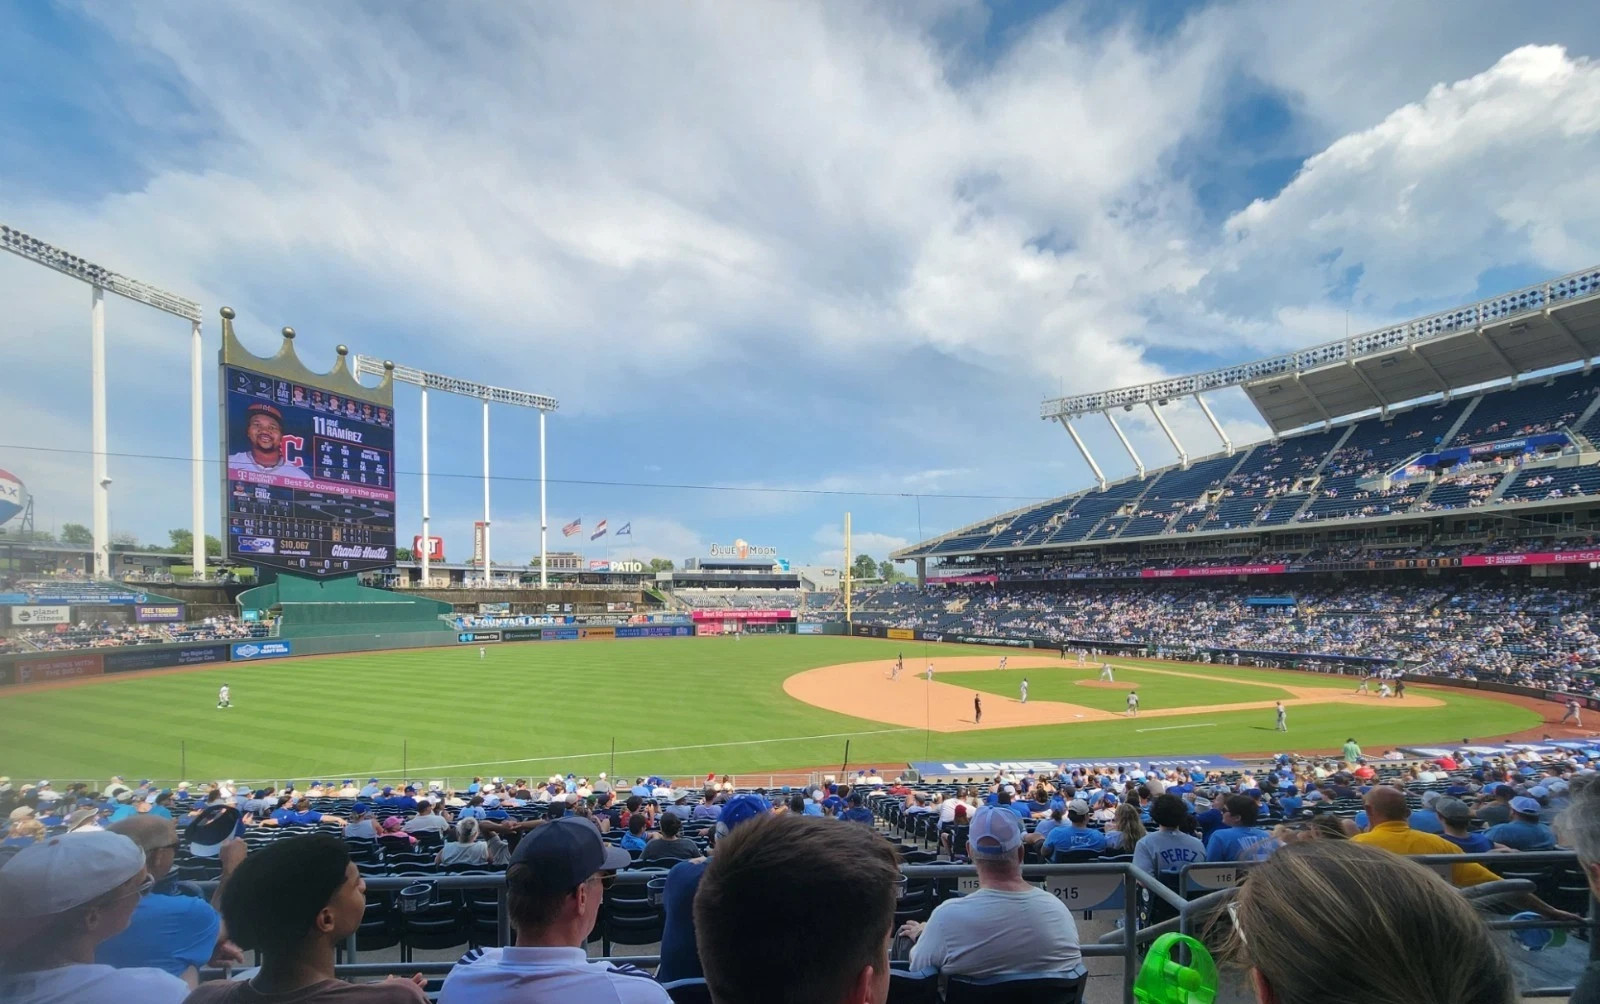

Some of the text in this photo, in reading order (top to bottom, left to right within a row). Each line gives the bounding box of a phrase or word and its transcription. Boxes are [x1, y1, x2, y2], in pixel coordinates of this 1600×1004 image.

[280, 382, 287, 390] AT
[277, 389, 289, 398] BAT
[312, 416, 326, 435] 11
[326, 426, 362, 443] RAMÍREZ
[281, 434, 304, 467] C
[1494, 440, 1526, 450] CHOPPER
[284, 478, 302, 486] Best
[316, 484, 349, 494] coverage
[254, 490, 270, 500] CRUZ
[280, 540, 310, 550] $10,067
[416, 538, 438, 554] QT
[710, 544, 776, 556] BLUE MOON
[332, 545, 388, 560] Charlie Hustle
[299, 558, 306, 568] 0
[324, 560, 330, 569] 0
[343, 560, 349, 570] 0
[611, 561, 642, 572] PATIO
[33, 608, 59, 616] planet
[476, 617, 554, 627] FOUNTAIN DECK
[942, 762, 1058, 770] UMB
[1071, 835, 1091, 846] PEREZ
[1161, 848, 1198, 864] PEREZ
[1216, 874, 1232, 882] 116
[1054, 888, 1078, 899] 215
